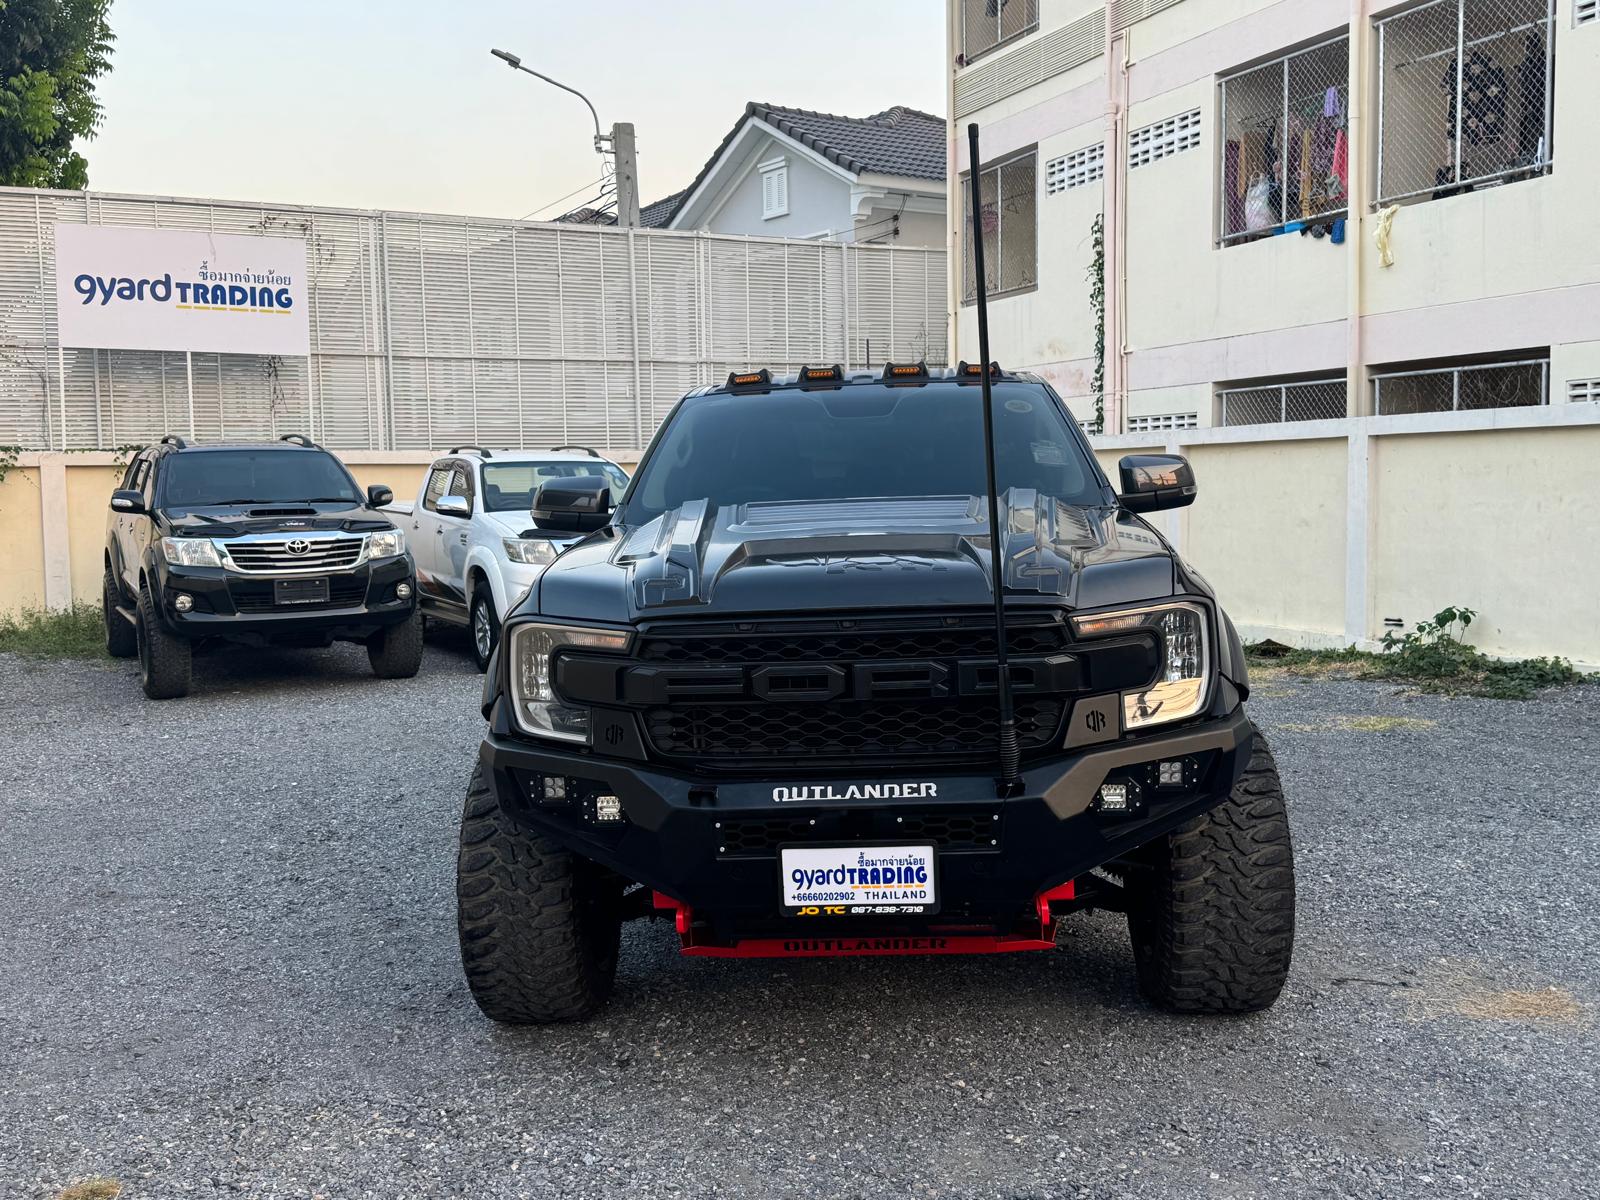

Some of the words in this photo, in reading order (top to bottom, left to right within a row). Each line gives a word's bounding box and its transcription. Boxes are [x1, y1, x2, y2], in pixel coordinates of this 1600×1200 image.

[198, 261, 292, 286] ซื้อมากจ่ายน้อย
[74, 273, 172, 306] 9yard
[175, 282, 293, 309] TRADING
[624, 656, 1077, 705] FORD
[772, 782, 938, 802] OUTLANDER
[791, 864, 846, 890] 9yard
[847, 866, 928, 885] TRADING
[791, 892, 855, 902] +66660202902
[865, 890, 927, 900] THAILAND
[796, 906, 820, 916] JO
[823, 905, 847, 915] TC
[784, 937, 948, 953] OUTLANDER
